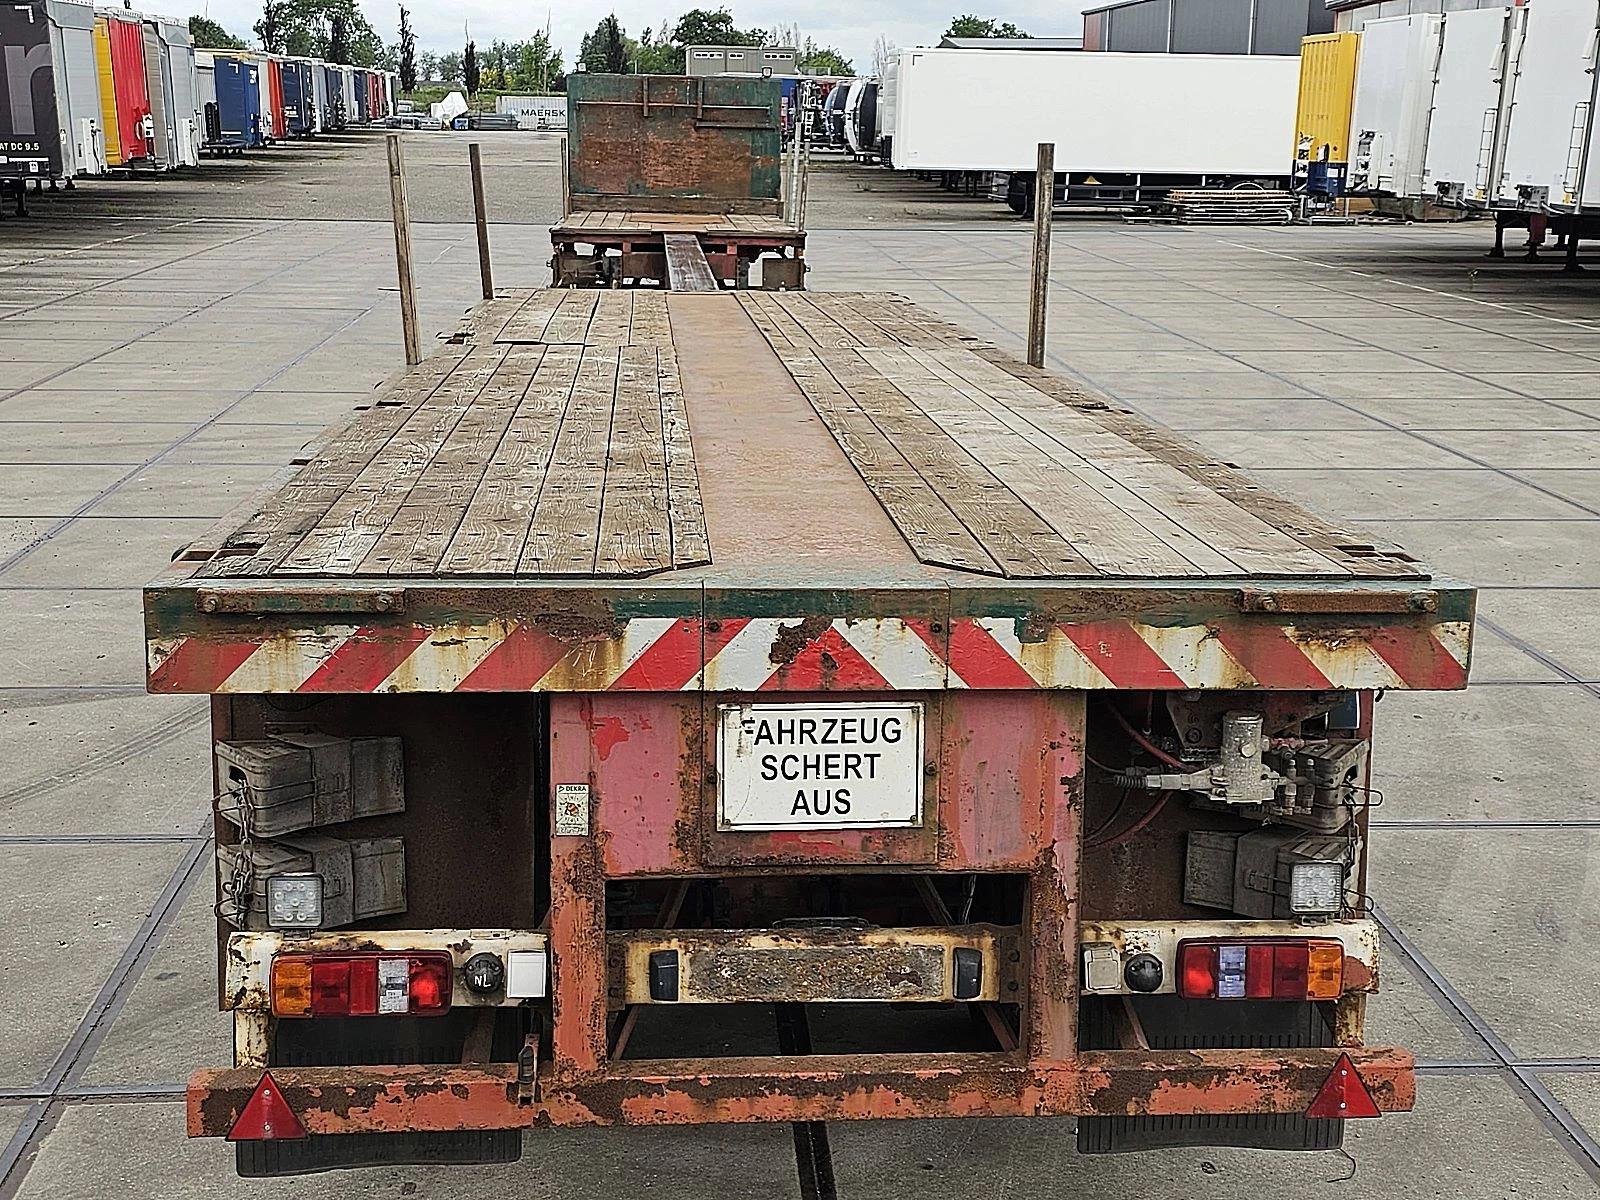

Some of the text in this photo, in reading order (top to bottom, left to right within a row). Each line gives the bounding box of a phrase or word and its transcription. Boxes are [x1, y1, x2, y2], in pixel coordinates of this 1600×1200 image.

[521, 109, 566, 117] MAERSK
[10, 142, 23, 151] DC
[25, 142, 40, 151] 9.5
[760, 753, 881, 781] SCHERT
[790, 788, 851, 815] AUS
[474, 973, 492, 988] NL
